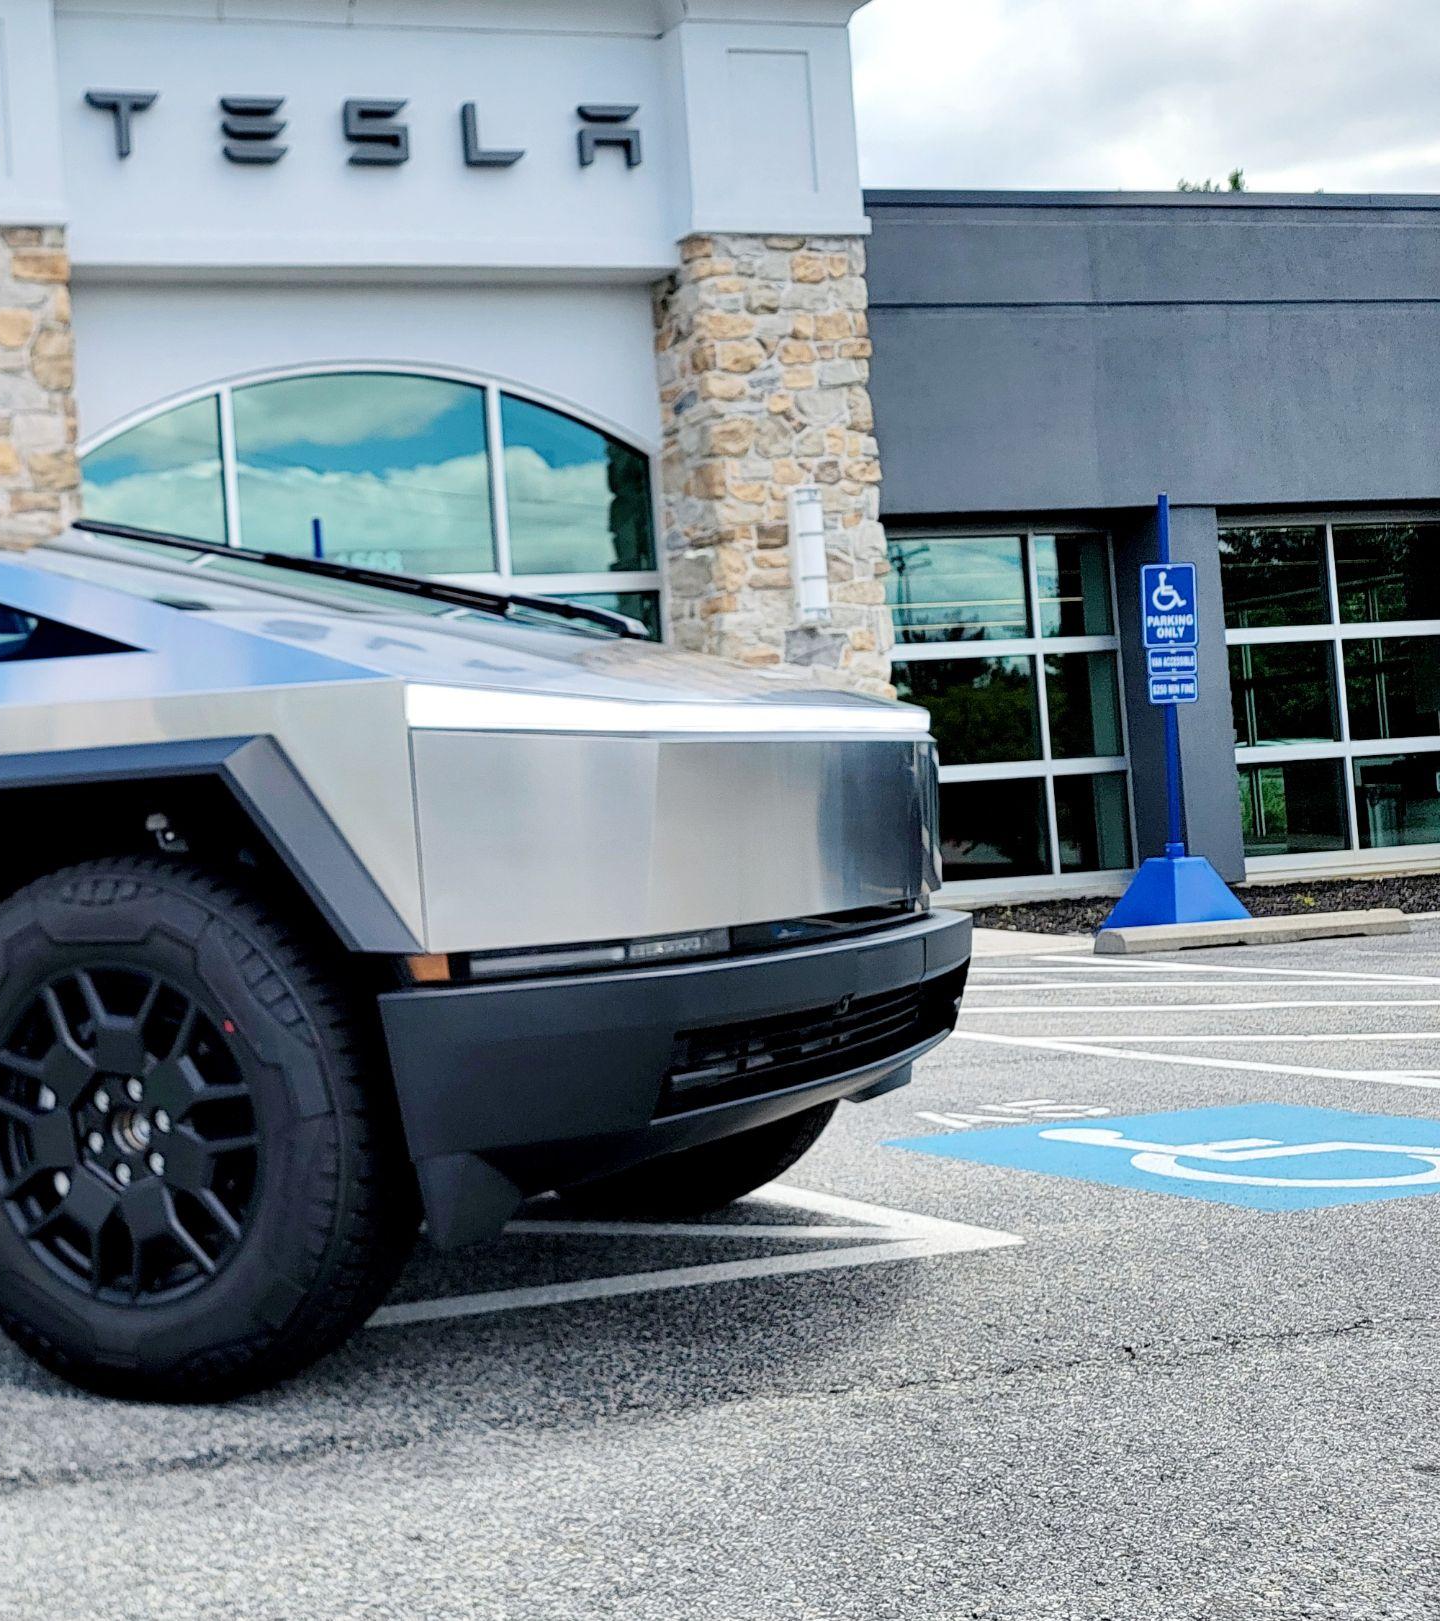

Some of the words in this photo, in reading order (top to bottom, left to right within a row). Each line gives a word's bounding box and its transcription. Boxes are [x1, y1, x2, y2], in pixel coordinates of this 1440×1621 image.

[83, 89, 644, 168] TESLA
[1147, 614, 1193, 627] PARKING
[1156, 627, 1185, 639] ONLY
[1181, 683, 1195, 694] FINE
